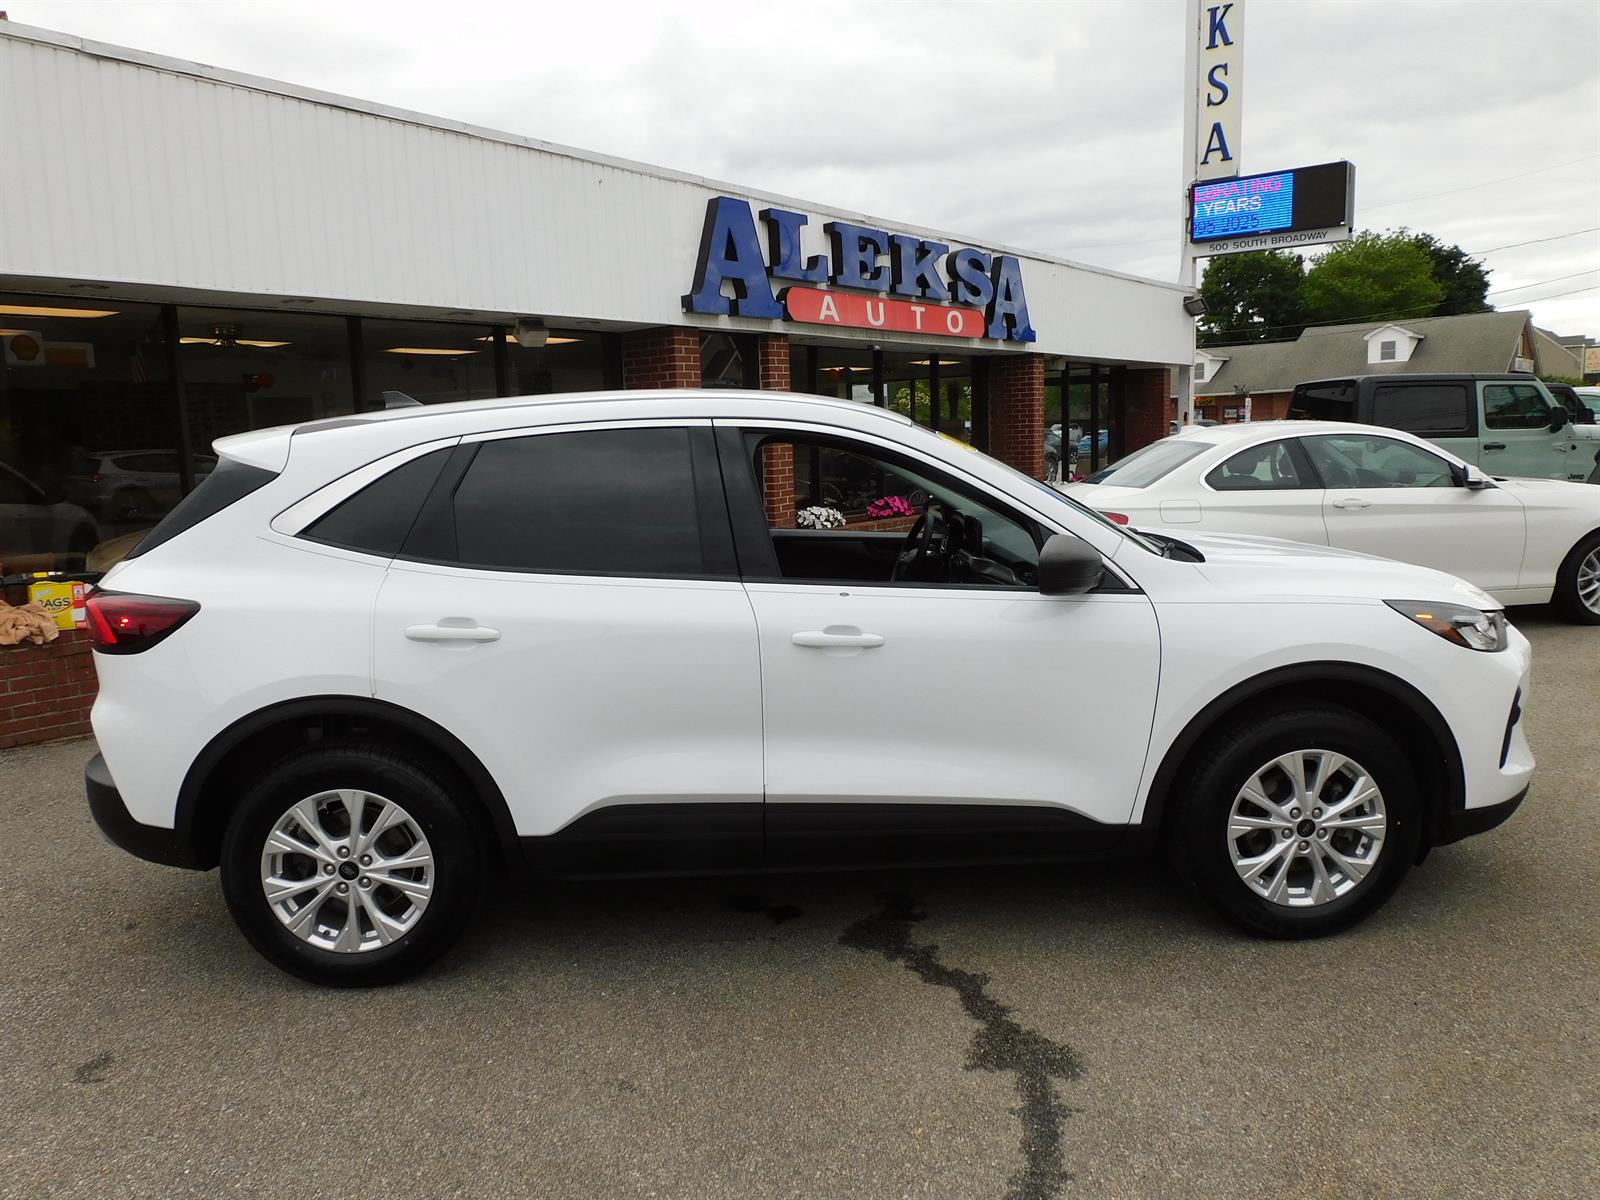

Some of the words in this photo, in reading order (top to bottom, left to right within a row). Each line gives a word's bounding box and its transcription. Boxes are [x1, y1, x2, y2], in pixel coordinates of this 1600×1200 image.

[1203, 196, 1262, 216] YEARS
[1209, 243, 1229, 252] 500
[1232, 239, 1267, 250] SOUTH
[1271, 231, 1329, 245] BROADWAY
[681, 196, 1036, 343] ALEKSA
[819, 295, 964, 334] AUTO
[1567, 472, 1585, 480] Jeep
